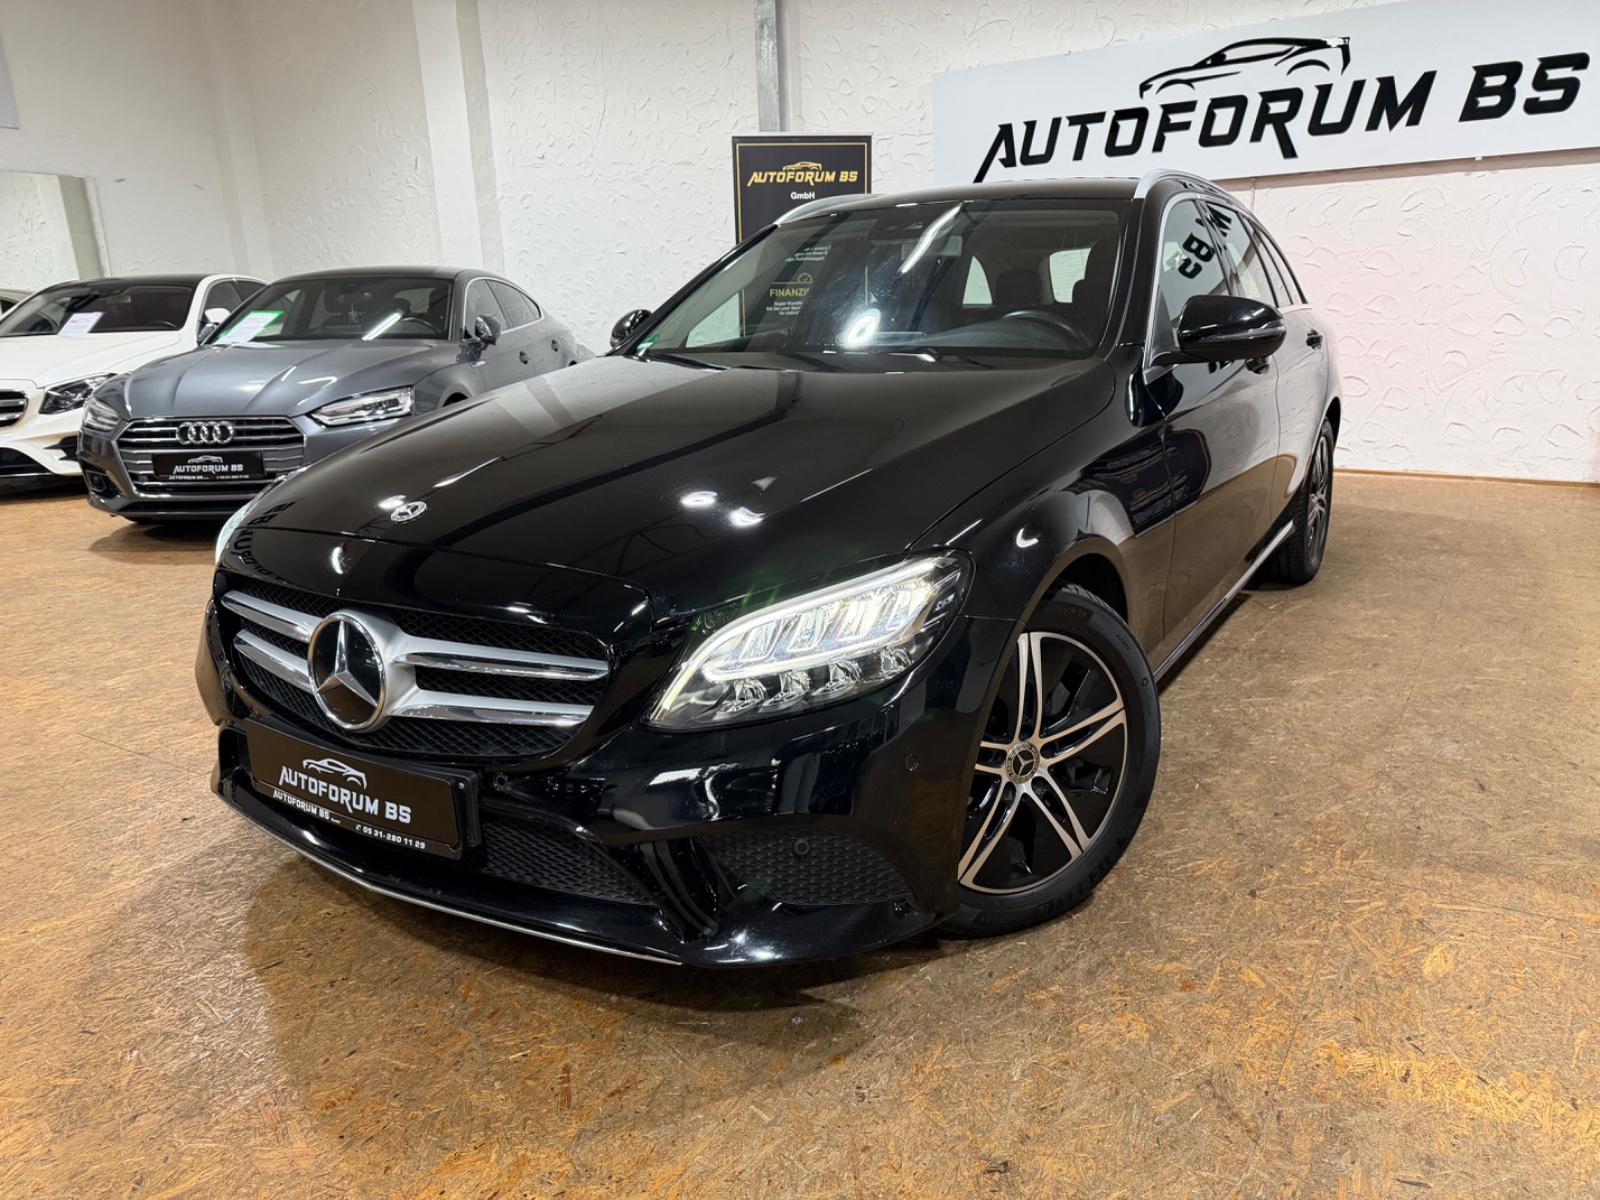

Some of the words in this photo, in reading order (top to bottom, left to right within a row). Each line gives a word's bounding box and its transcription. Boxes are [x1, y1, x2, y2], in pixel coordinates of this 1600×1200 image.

[973, 70, 1437, 183] AUTOFORUM
[1458, 52, 1590, 122] BS
[747, 171, 835, 187] AUTOFORUM
[839, 171, 858, 182] BS
[790, 191, 815, 199] GmbH
[173, 464, 228, 474] AUTOFORUM
[231, 464, 244, 472] BS
[273, 789, 317, 814] AUTOFORUM
[279, 765, 379, 816] AUTOFORUM
[385, 801, 412, 824] BS
